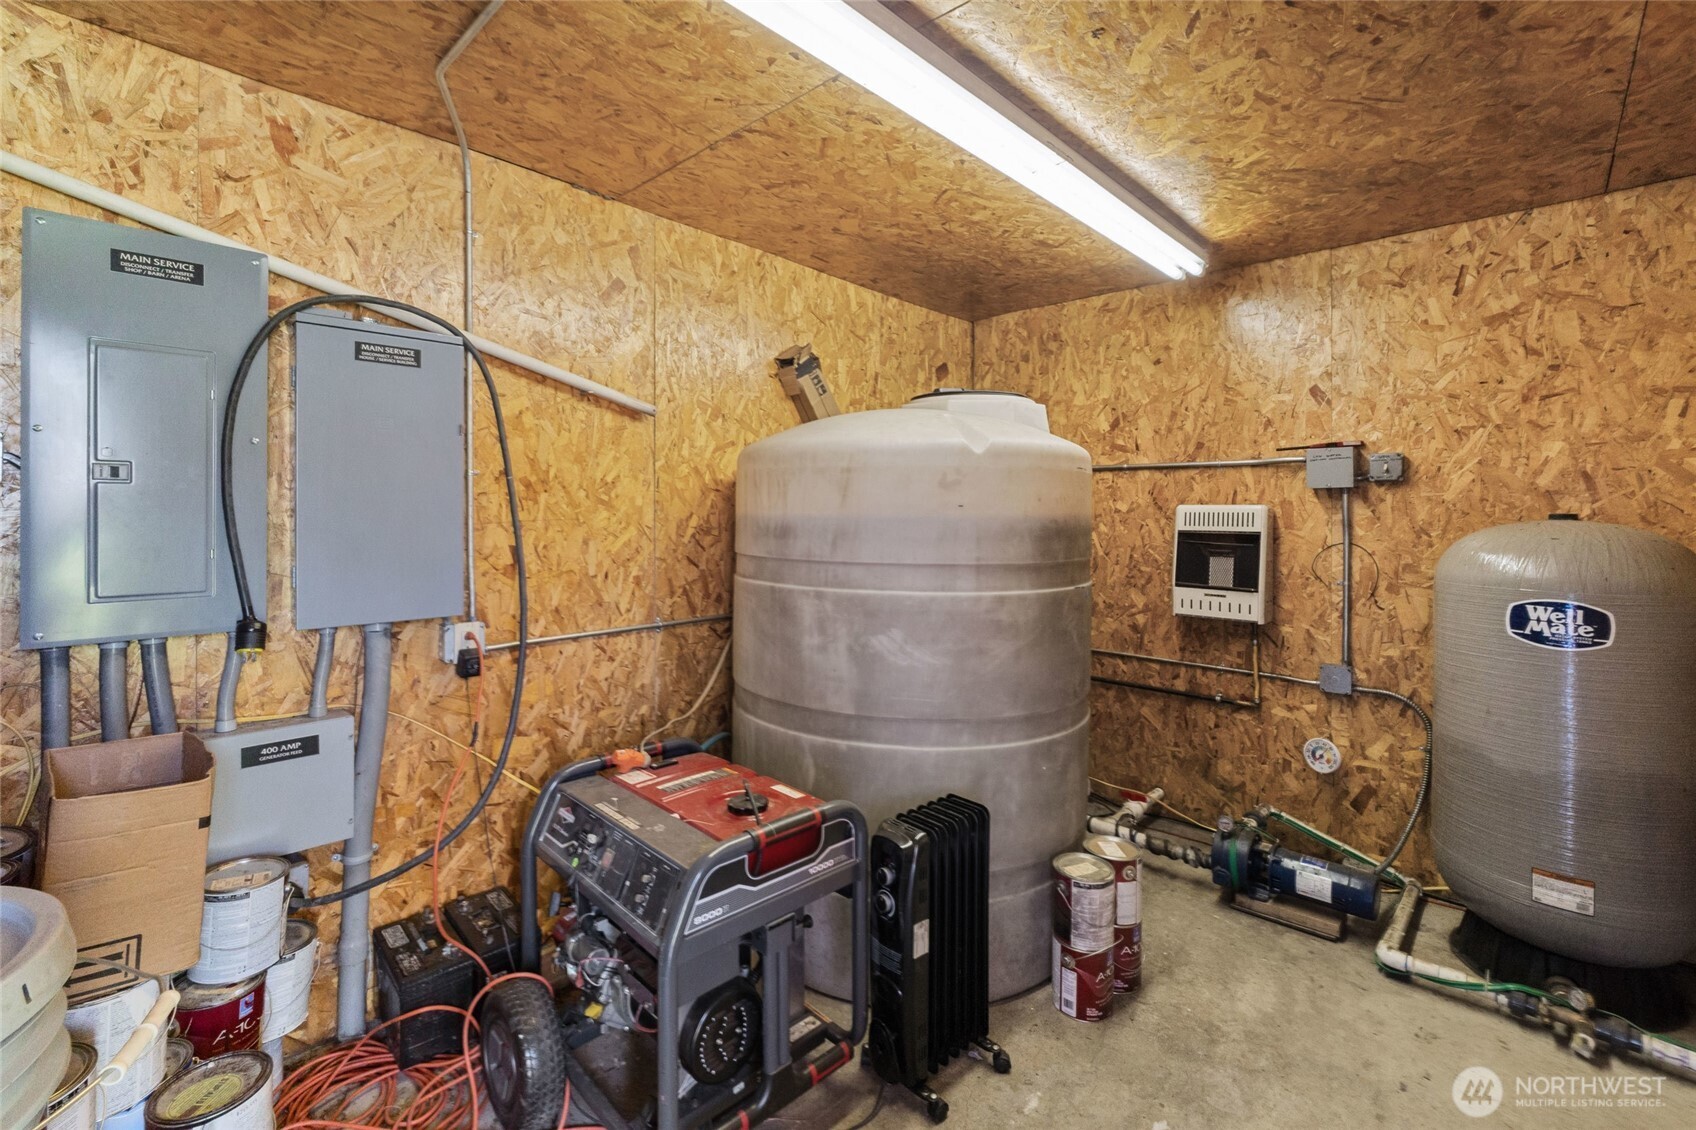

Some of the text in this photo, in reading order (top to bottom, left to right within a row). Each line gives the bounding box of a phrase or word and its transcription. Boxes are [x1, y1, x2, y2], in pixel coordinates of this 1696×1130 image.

[120, 252, 195, 272] MAIN SERVICE
[120, 261, 160, 272] DISCONNECT
[165, 269, 194, 278] TRANSFER
[147, 270, 165, 278] BARN
[170, 274, 191, 282] ARENA
[361, 343, 415, 357] MAIN SERVICE
[1524, 604, 1585, 626] Well
[1523, 620, 1595, 637] Mate
[260, 741, 302, 755] 400 AMP
[259, 751, 290, 761] GENERATOR
